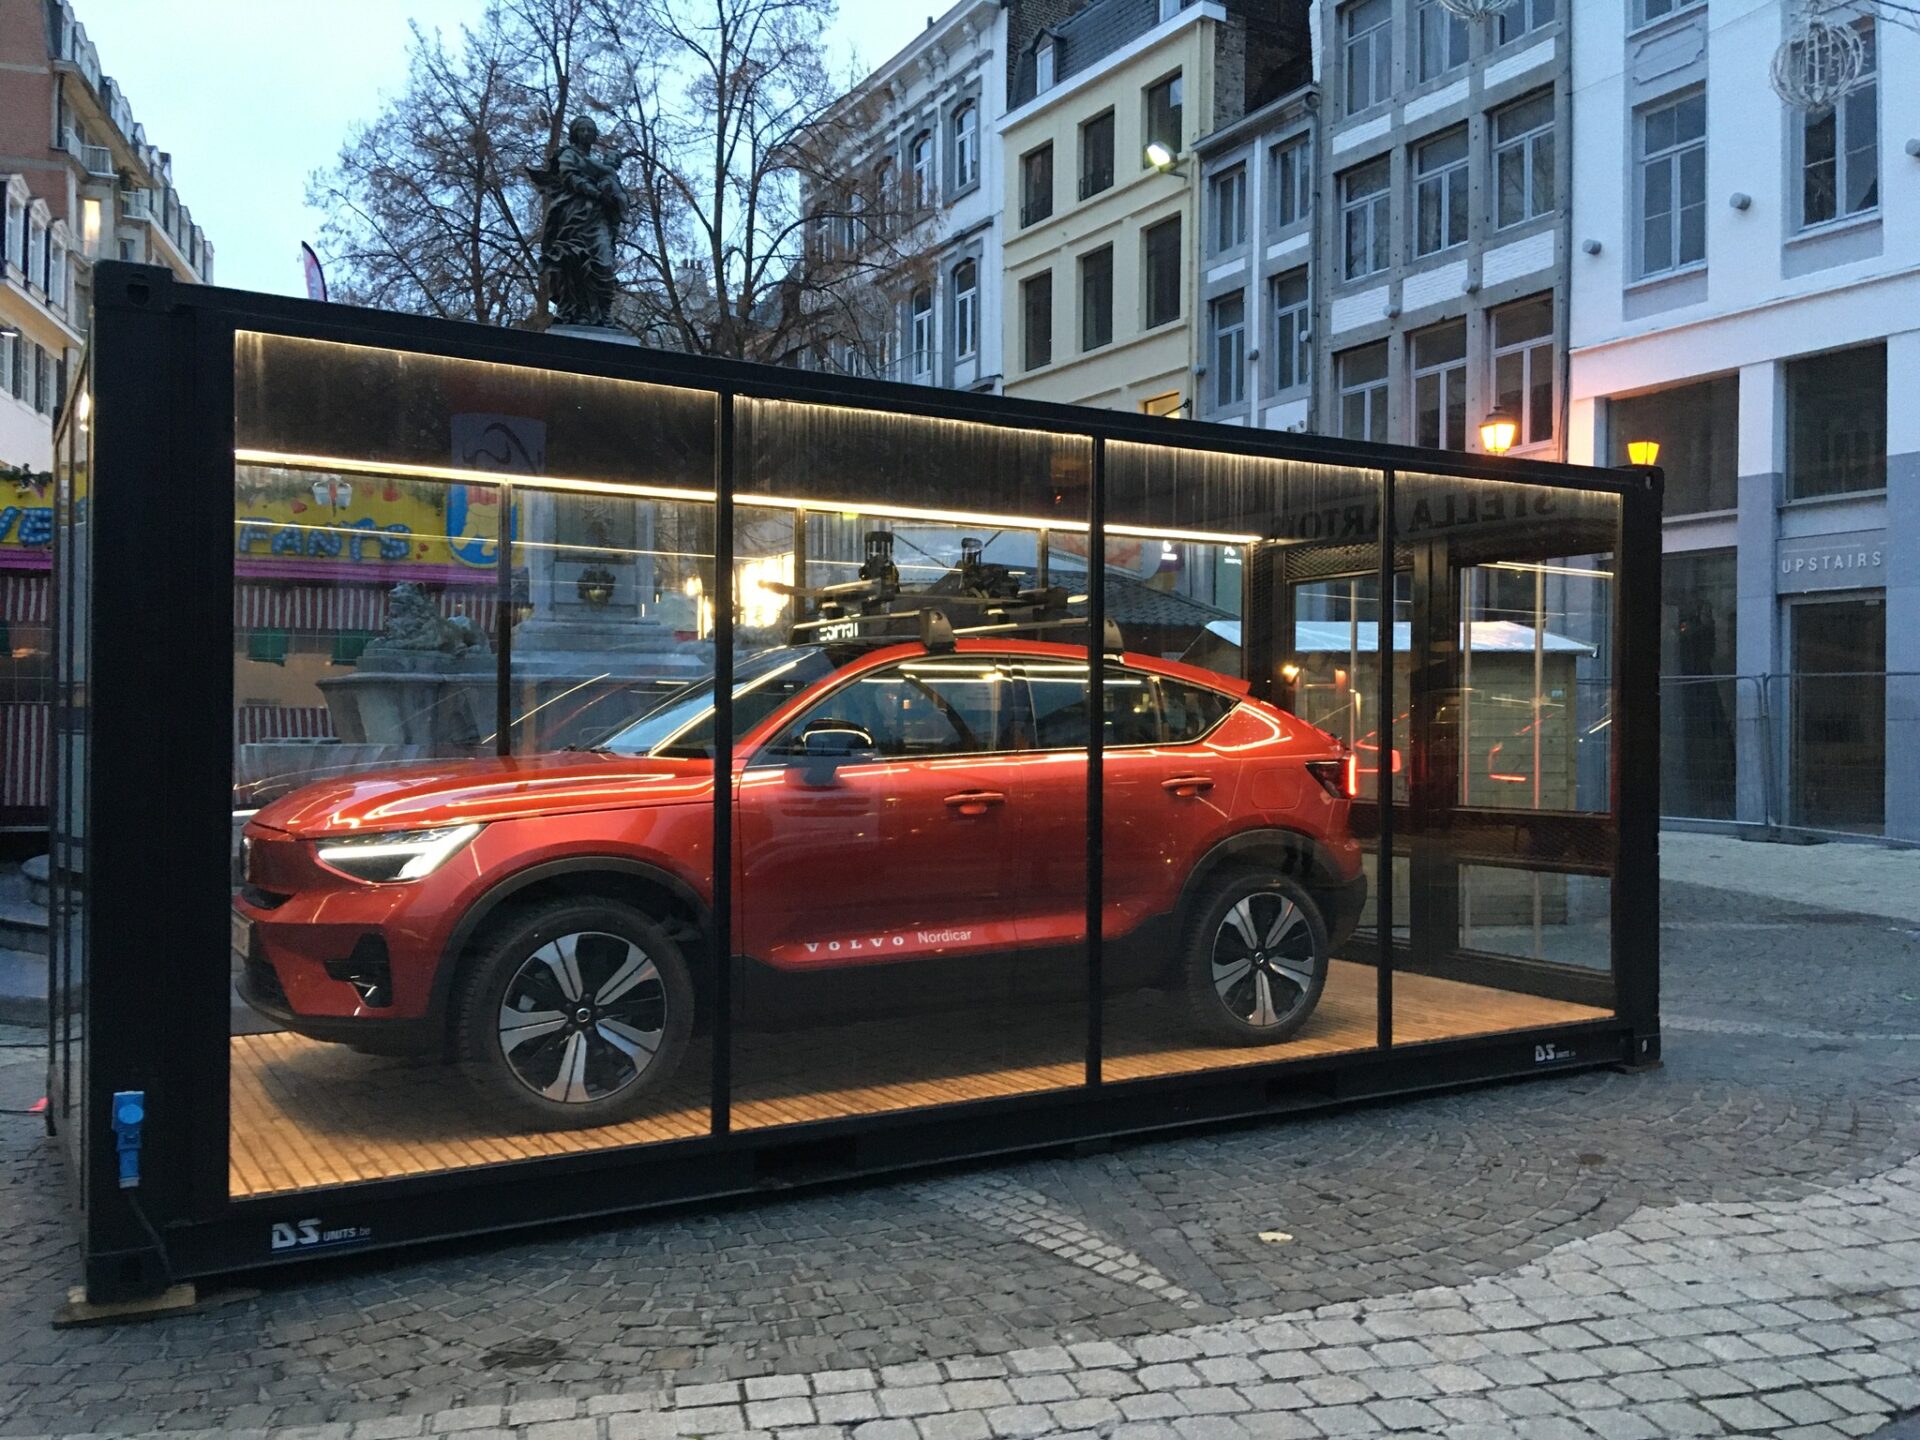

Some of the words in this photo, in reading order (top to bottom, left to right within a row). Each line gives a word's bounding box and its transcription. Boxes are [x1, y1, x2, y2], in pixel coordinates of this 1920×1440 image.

[1782, 551, 1881, 574] UPSTAIRS
[805, 936, 904, 953] VOLVO
[918, 930, 972, 944] Nordicar
[272, 1218, 321, 1249] DS
